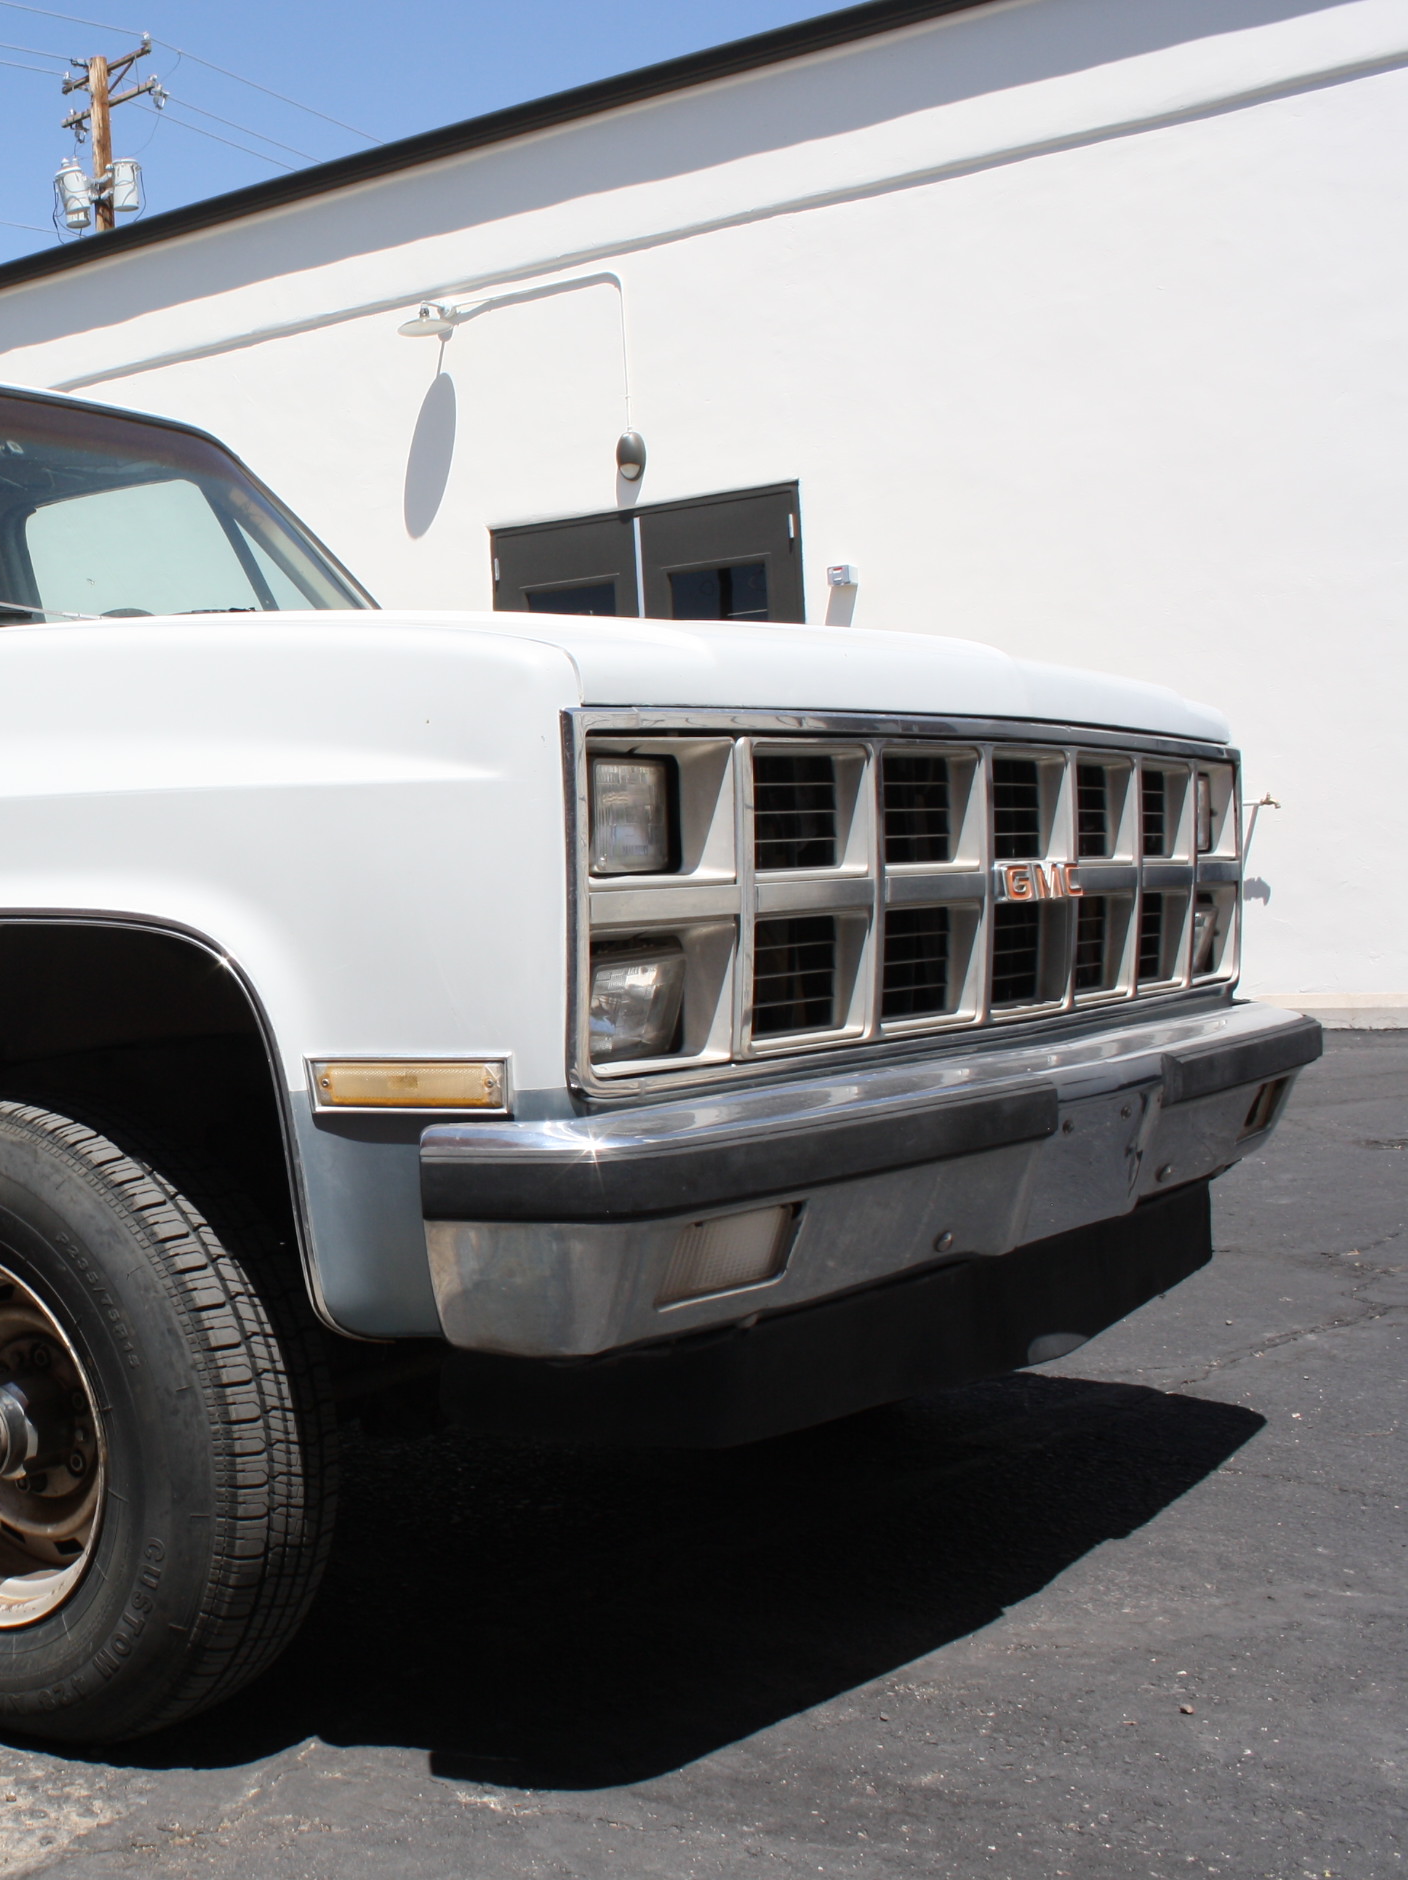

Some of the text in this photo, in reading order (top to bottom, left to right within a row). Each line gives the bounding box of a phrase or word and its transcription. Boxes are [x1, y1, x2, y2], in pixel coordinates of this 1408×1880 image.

[1002, 862, 1083, 900] GMC
[54, 1231, 141, 1370] P235/75R15
[92, 1535, 167, 1682] CUSTOM
